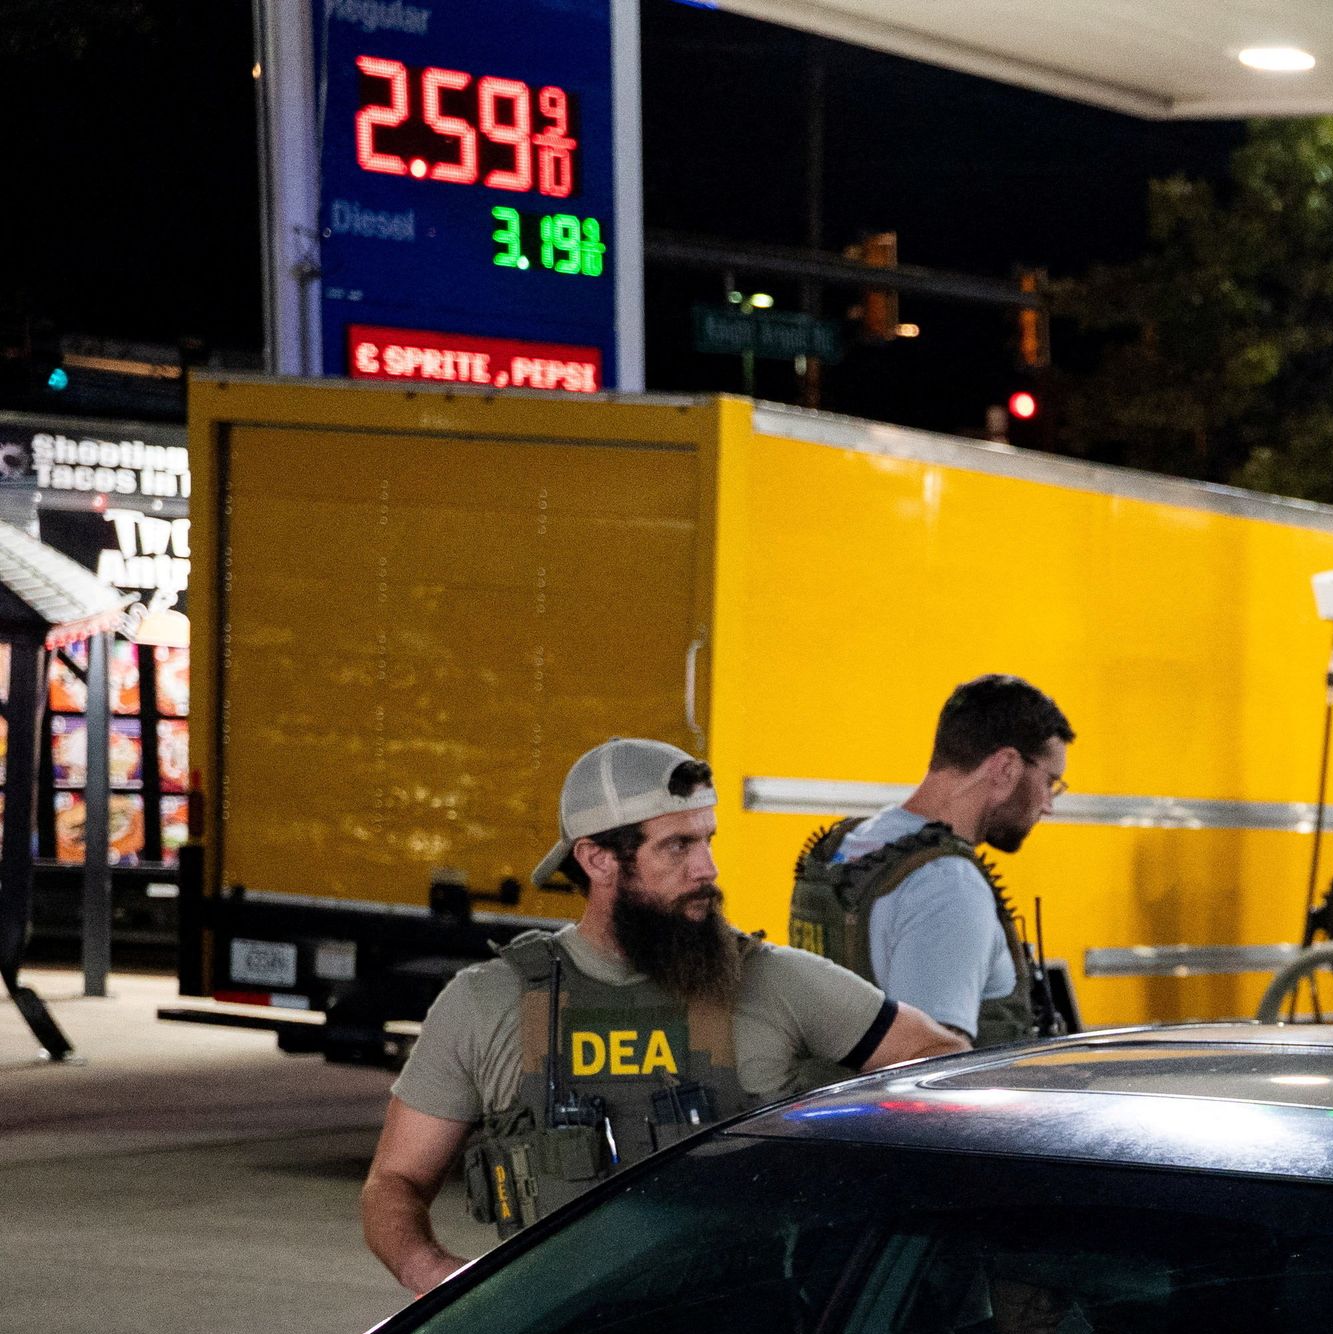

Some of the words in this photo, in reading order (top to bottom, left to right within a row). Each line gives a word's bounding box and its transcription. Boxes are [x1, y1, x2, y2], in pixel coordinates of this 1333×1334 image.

[355, 54, 532, 192] 2.59
[331, 199, 416, 241] Diesel
[491, 206, 581, 275] 3.19
[34, 465, 137, 494] Tacos
[571, 1029, 678, 1076] DEA
[495, 1164, 511, 1219] DEA
